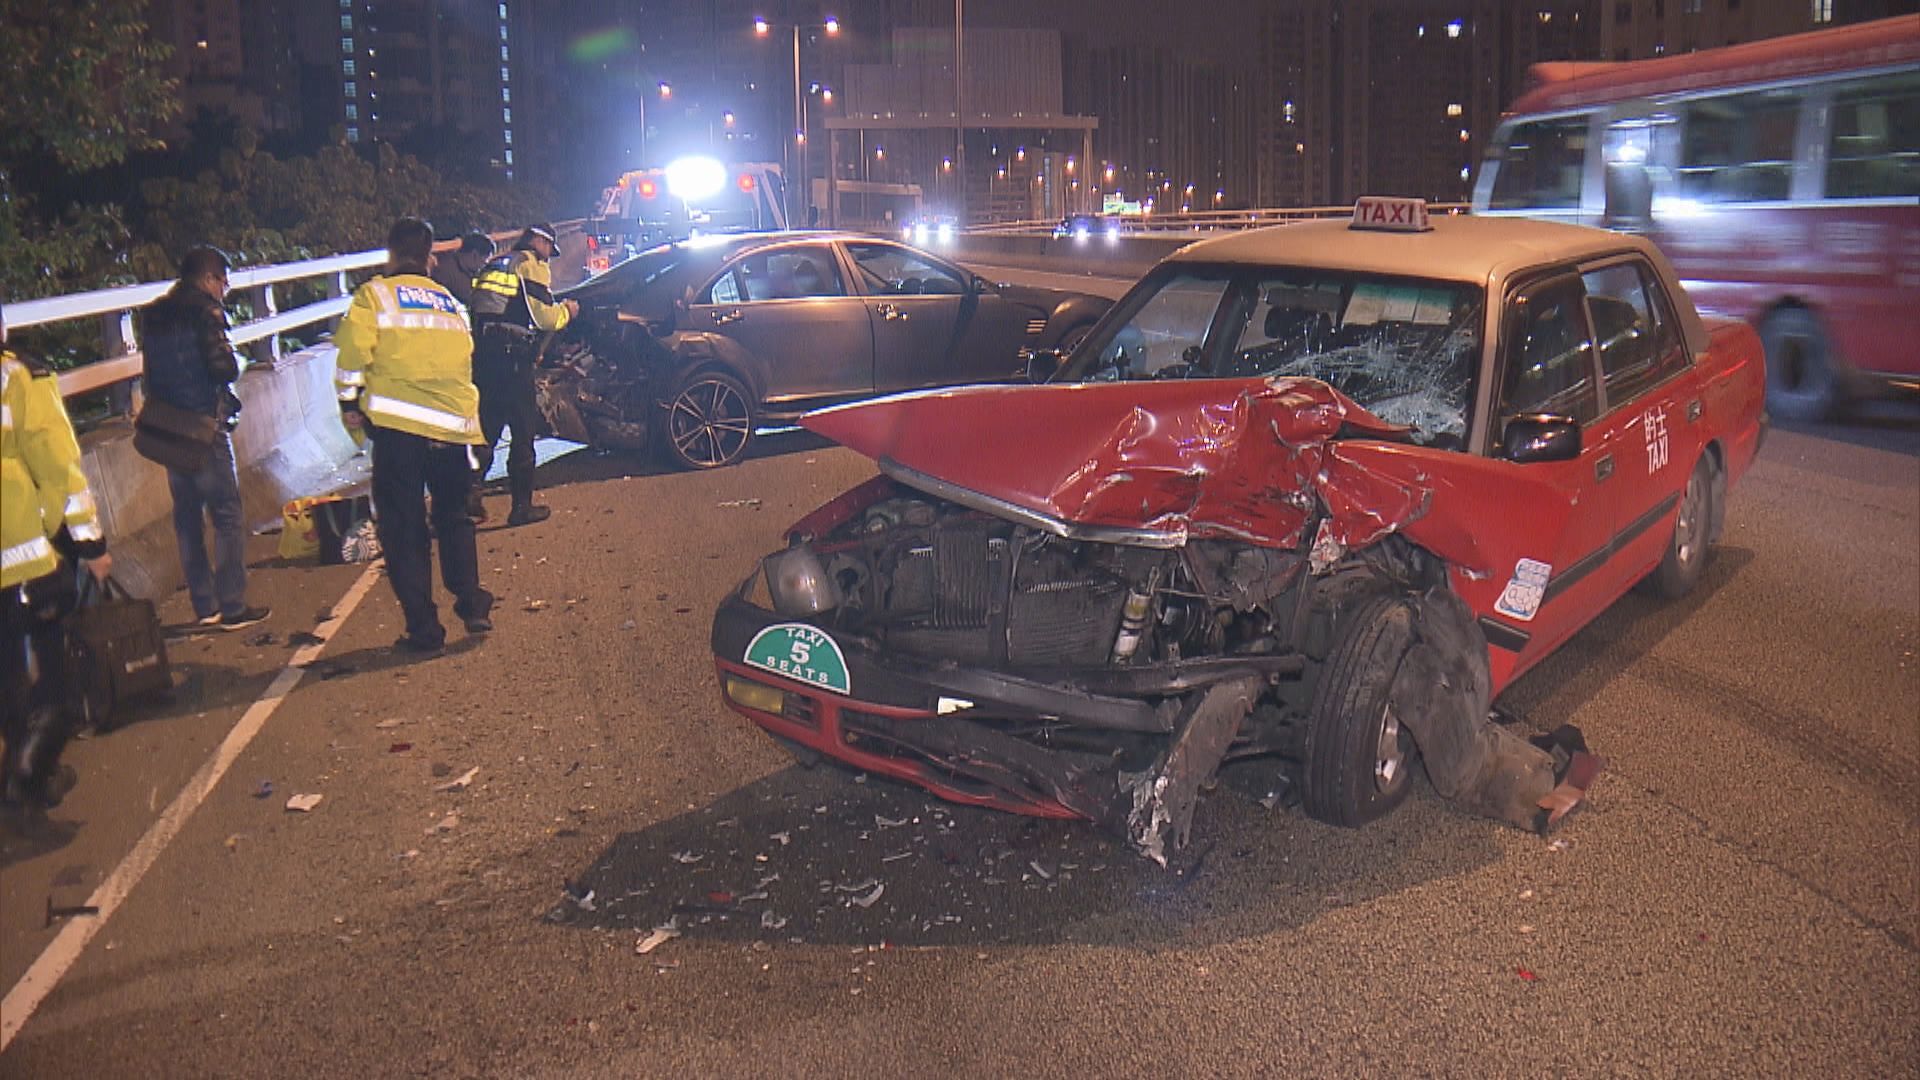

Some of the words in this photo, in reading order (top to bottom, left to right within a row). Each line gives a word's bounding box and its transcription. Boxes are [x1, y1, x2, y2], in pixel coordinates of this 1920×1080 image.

[1359, 202, 1415, 223] TAXI
[1644, 406, 1667, 443] 的士
[1646, 434, 1669, 475] TAXI
[785, 628, 825, 647] TAXI
[789, 641, 811, 664] 5
[766, 656, 829, 684] SEATS
